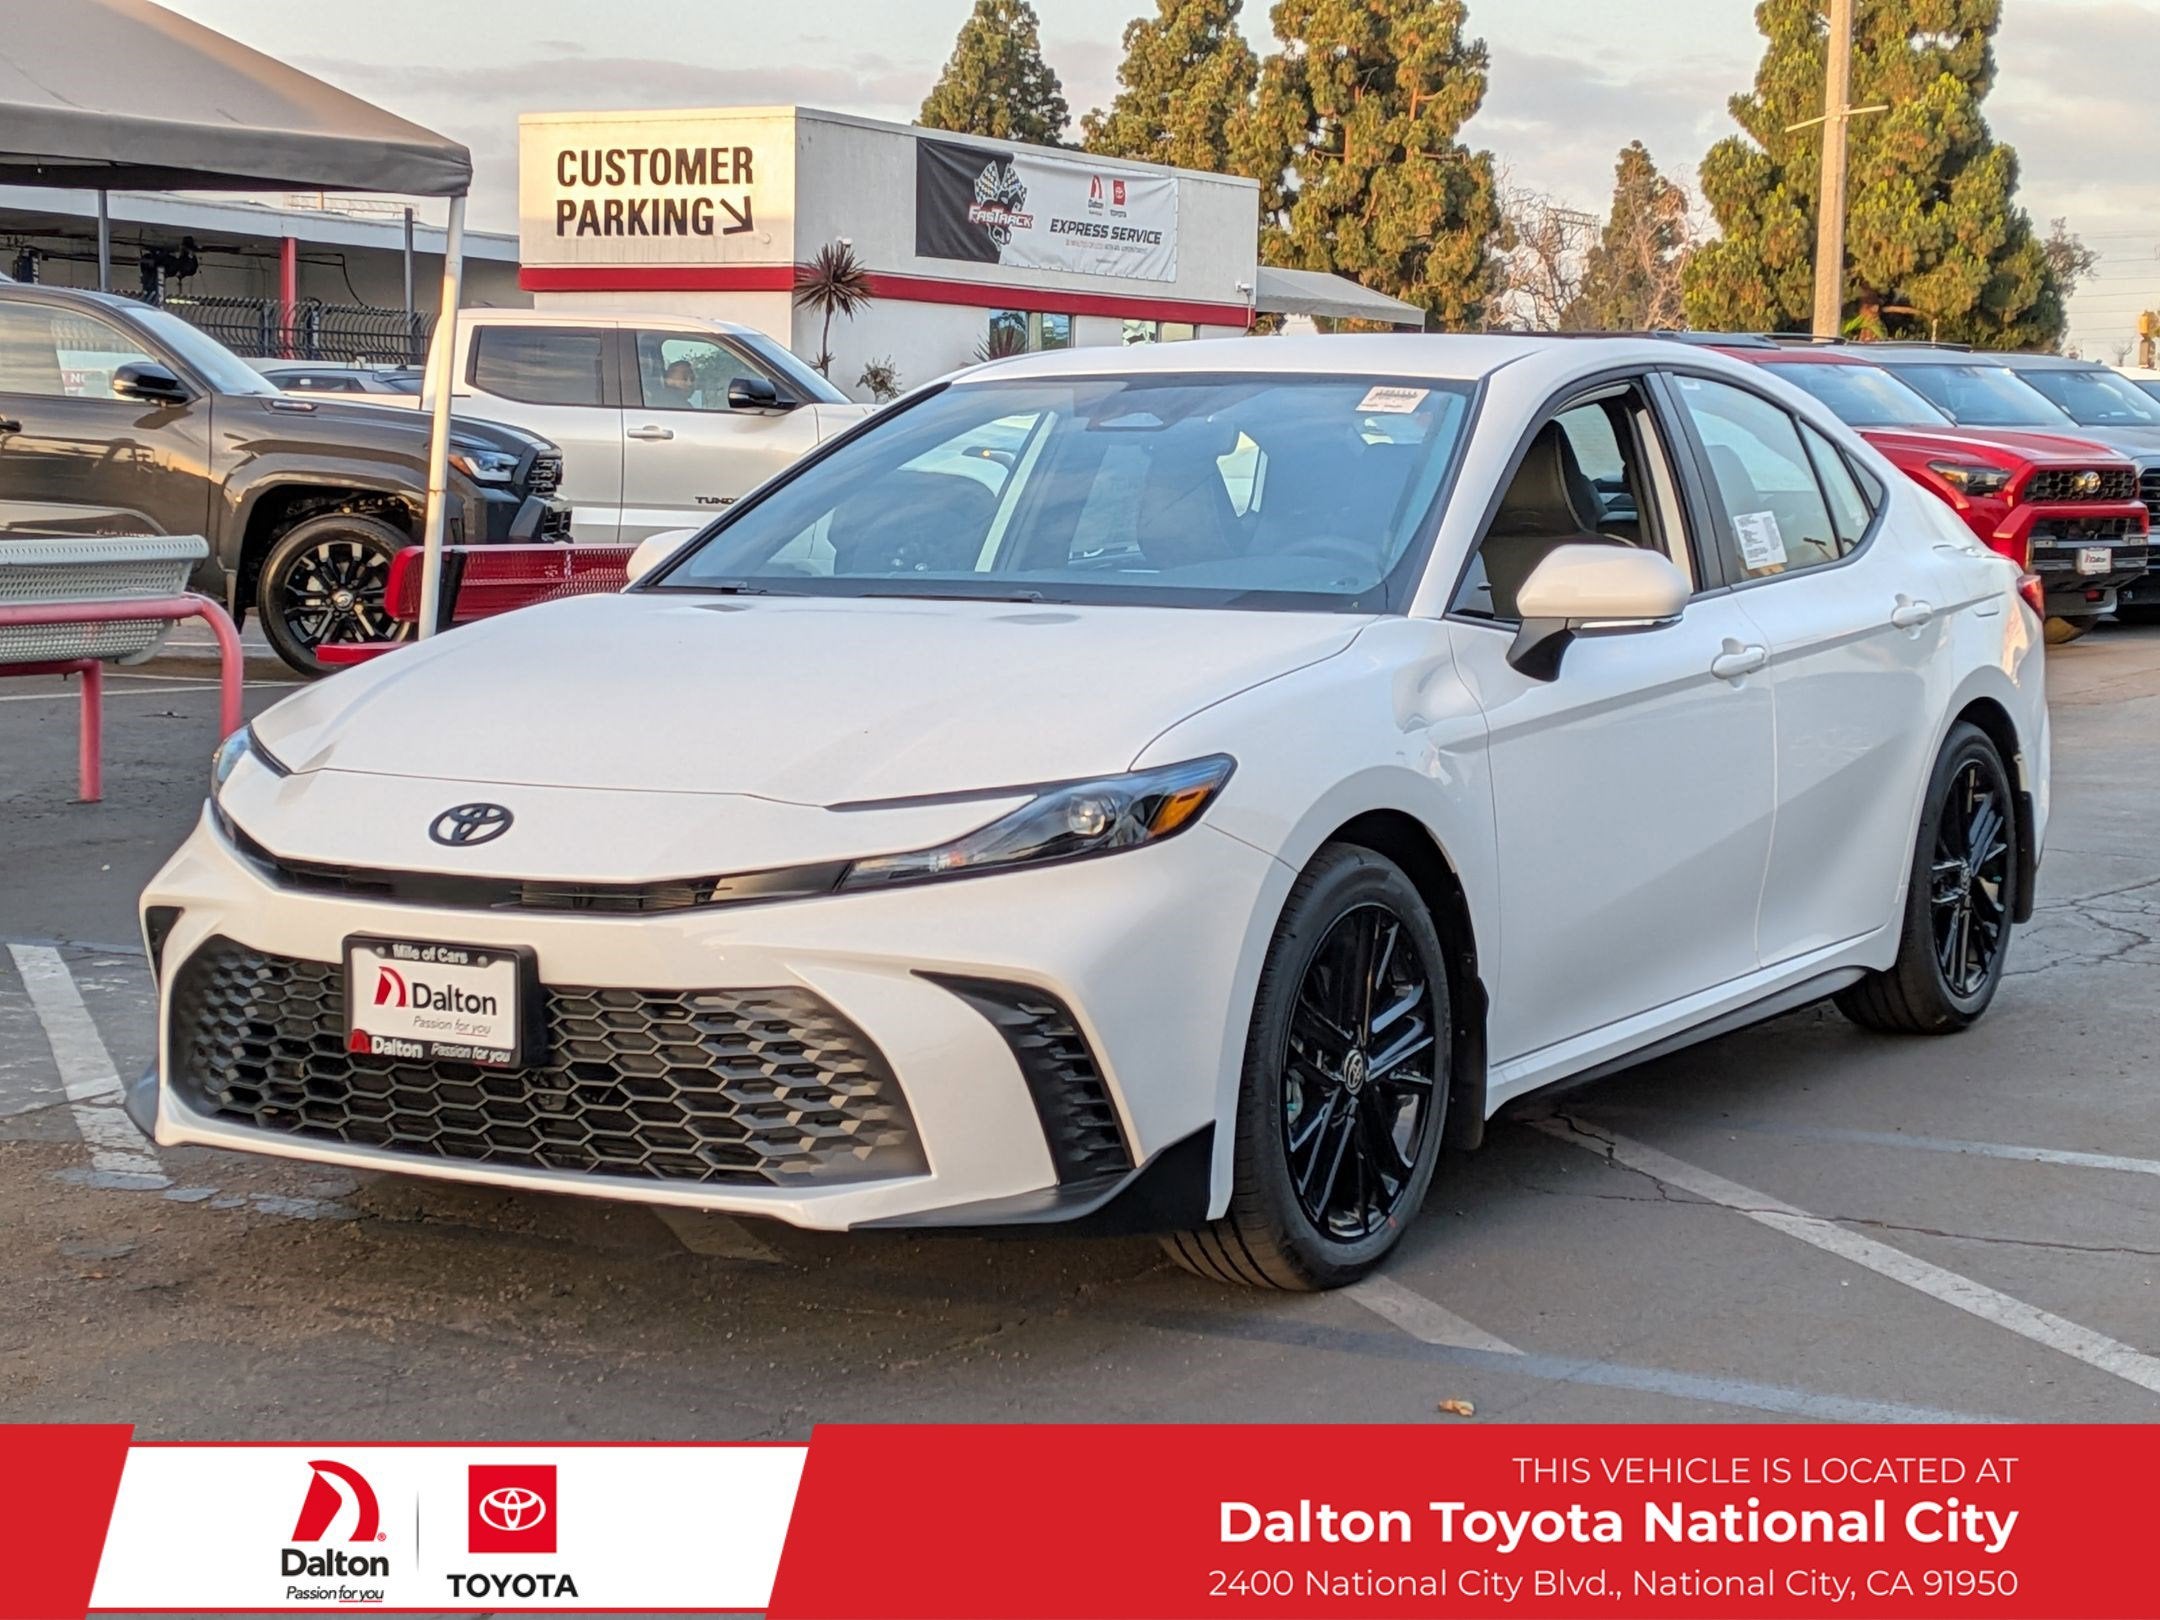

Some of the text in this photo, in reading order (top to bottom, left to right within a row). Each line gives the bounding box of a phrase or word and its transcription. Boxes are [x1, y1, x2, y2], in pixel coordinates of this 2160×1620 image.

[557, 146, 753, 187] CUSTOMER
[557, 196, 714, 237] PARKING
[1050, 218, 1162, 245] EXPRESS SERVICE
[392, 944, 468, 964] Mile of Cars
[412, 982, 497, 1016] Dalton
[413, 1015, 491, 1035] Passion for you
[371, 1036, 511, 1063] Dalton Passion for you
